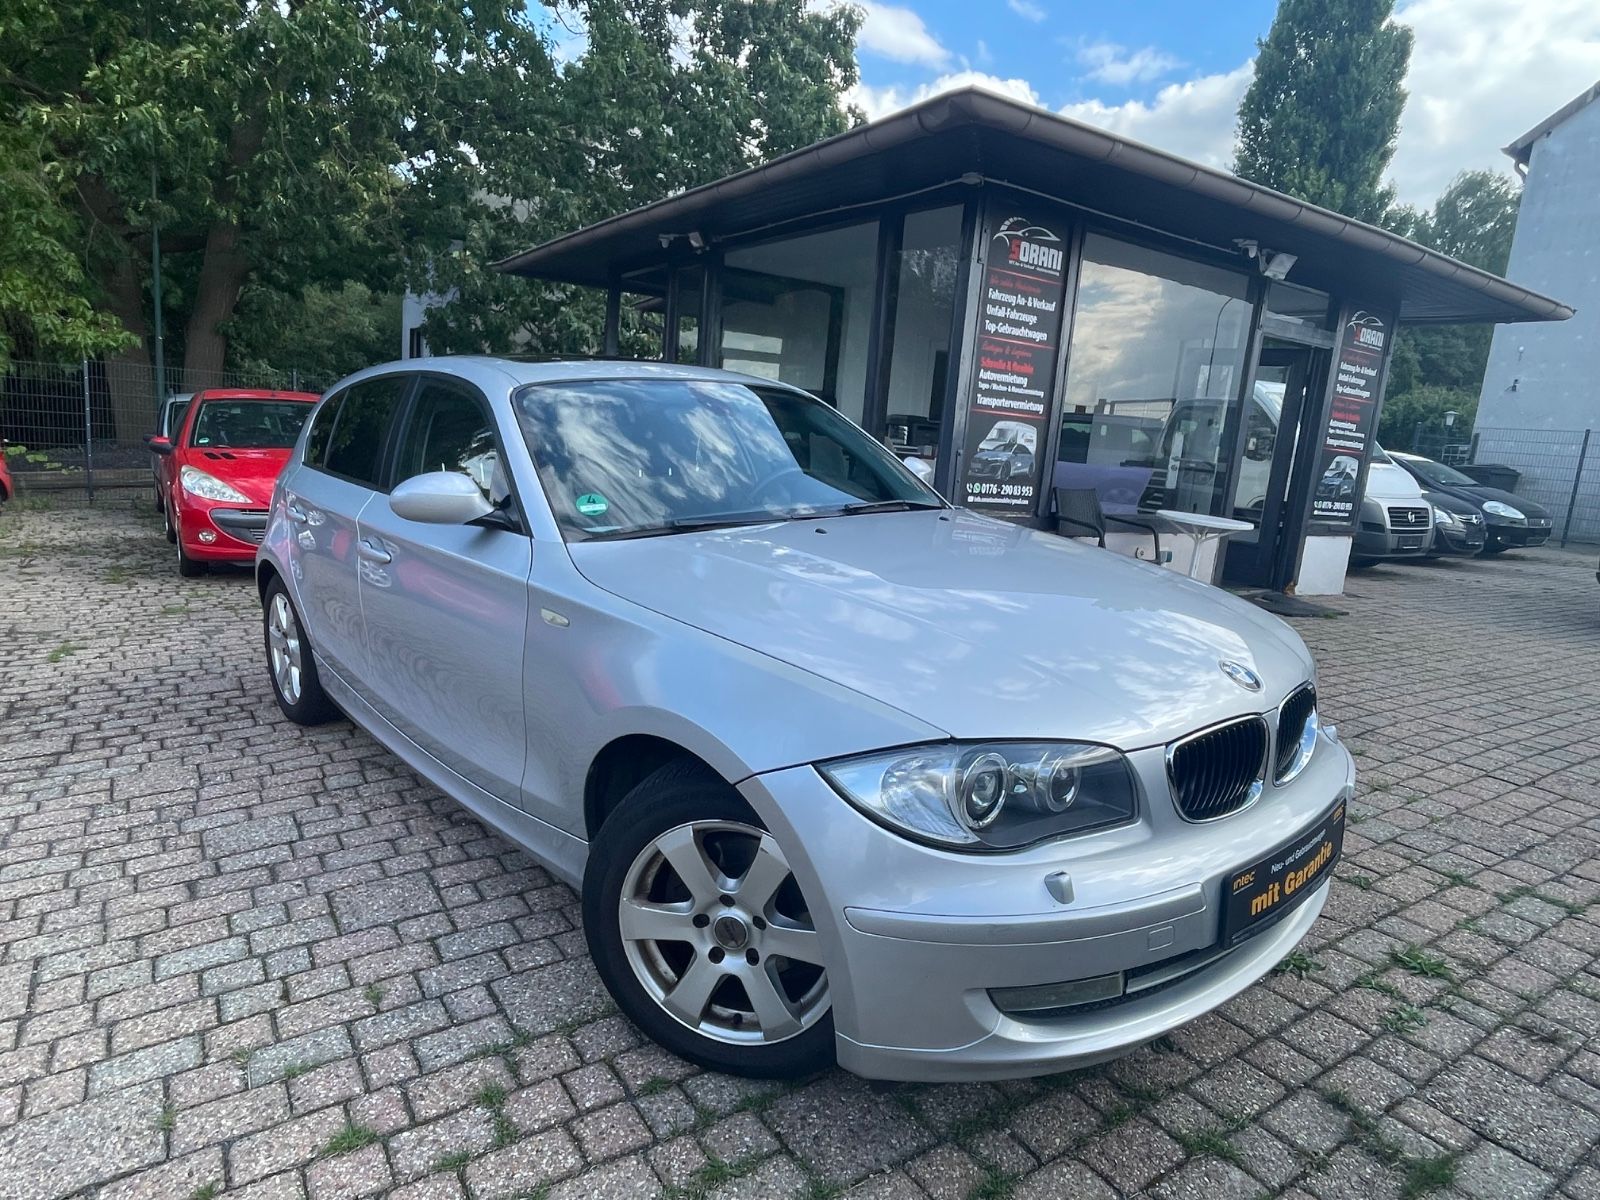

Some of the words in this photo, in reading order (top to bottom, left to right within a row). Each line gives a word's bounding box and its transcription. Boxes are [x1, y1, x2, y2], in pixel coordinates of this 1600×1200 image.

[1009, 239, 1063, 271] SORANI
[988, 287, 1016, 306] Fahrzeug
[1027, 296, 1033, 306] &
[1033, 297, 1056, 311] Verkauf
[986, 304, 1037, 325] Unfall-Fahrzeuge
[985, 320, 1047, 342] Top-Gebrauchtwagen
[979, 368, 1028, 388] Autovermietung
[977, 393, 1044, 414] Transportervermietung
[981, 483, 997, 494] 0176
[587, 495, 597, 504] 4
[1270, 862, 1284, 874] Neu-
[1285, 852, 1295, 866] und
[1251, 881, 1280, 916] mit
[1284, 841, 1333, 895] Garantie
